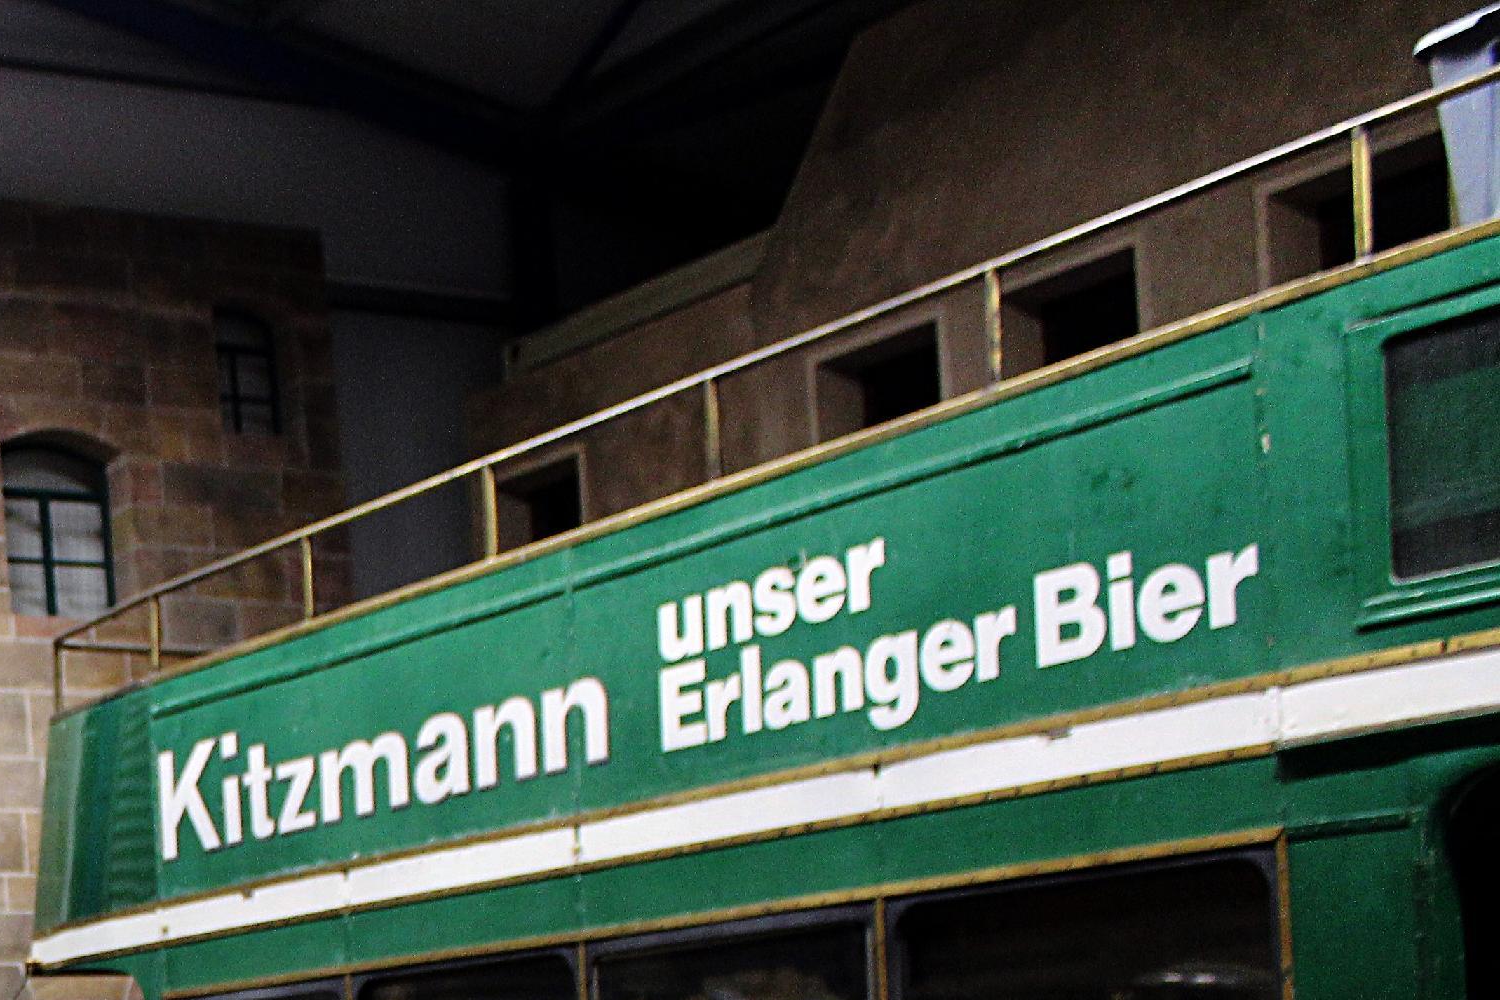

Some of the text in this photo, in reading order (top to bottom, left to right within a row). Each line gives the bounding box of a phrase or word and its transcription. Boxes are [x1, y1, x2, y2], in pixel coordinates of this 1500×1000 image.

[657, 537, 886, 662] unser
[659, 543, 1259, 753] Erlanger Bier
[158, 676, 610, 862] Kitzmann
